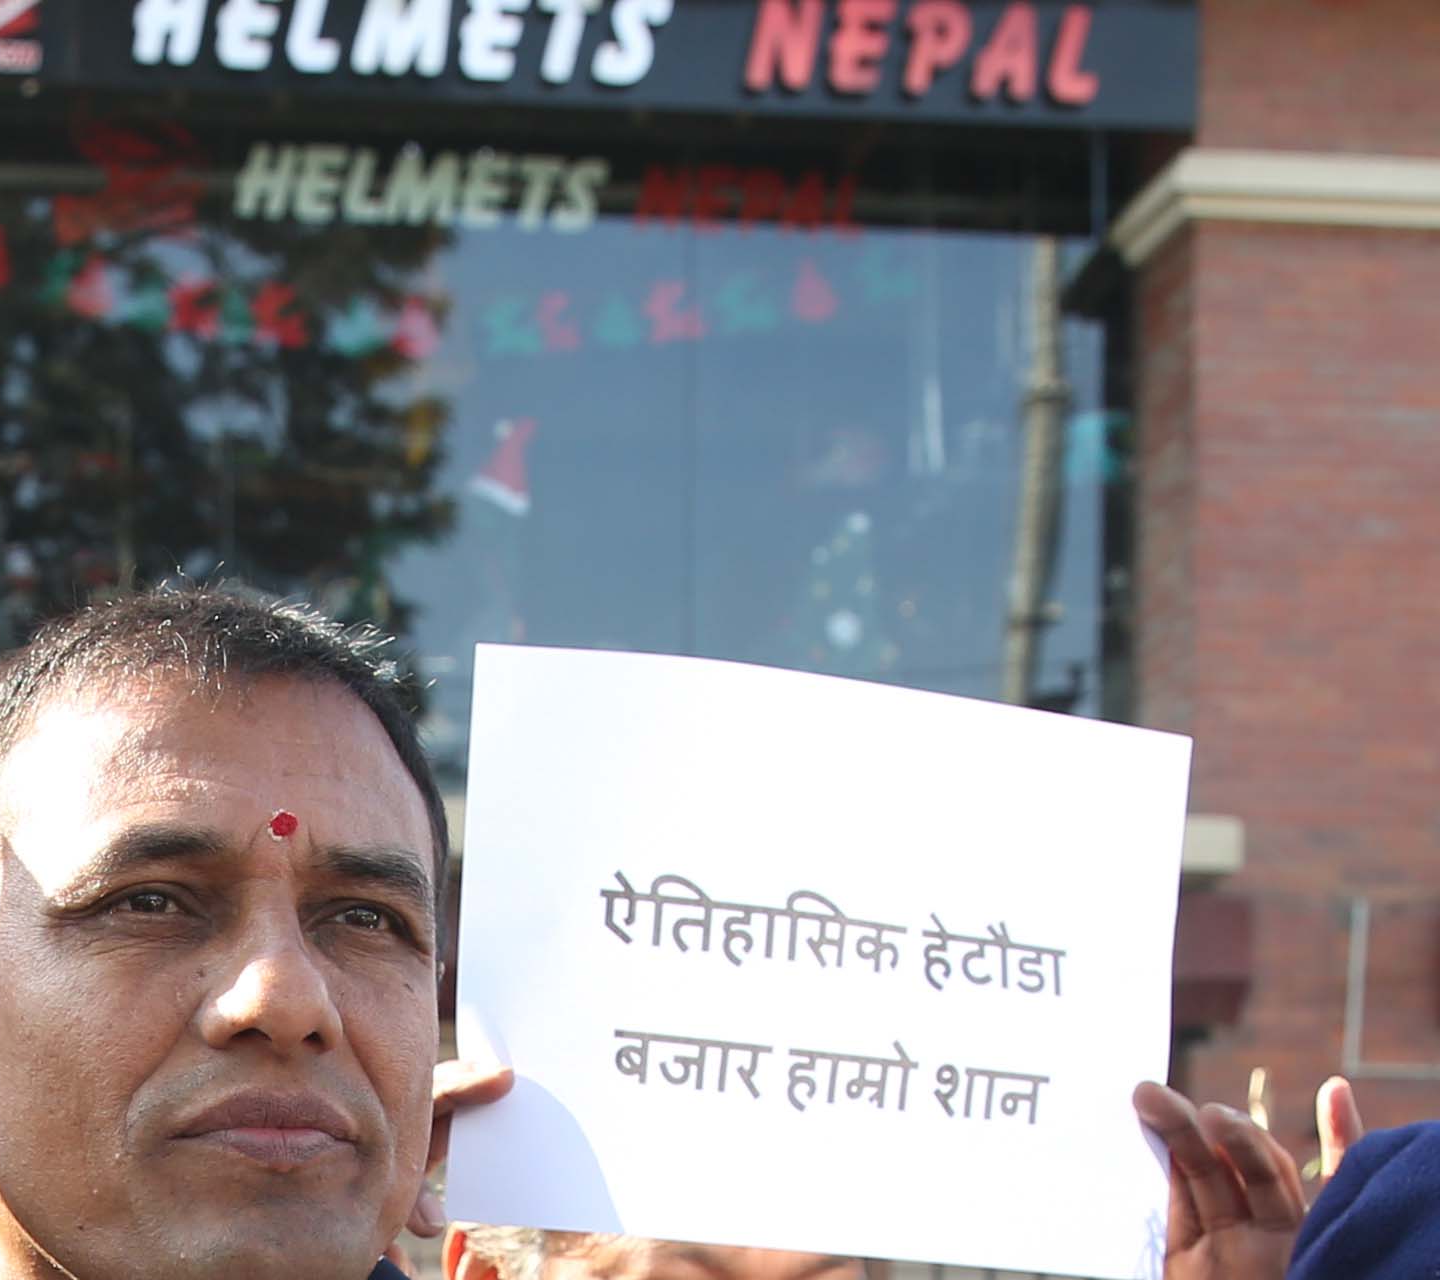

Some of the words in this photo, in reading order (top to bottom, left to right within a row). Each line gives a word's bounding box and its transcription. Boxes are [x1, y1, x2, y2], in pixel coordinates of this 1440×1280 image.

[131, 0, 674, 86] HELMETS
[744, 0, 1099, 103] NEPAL
[234, 146, 610, 234] HELMETS
[634, 163, 864, 240] NEPAL
[600, 871, 907, 972] ऐतिहासिक
[614, 1030, 772, 1098] बजार
[788, 1041, 918, 1111] हाम्रो
[934, 1064, 1050, 1124] शान
